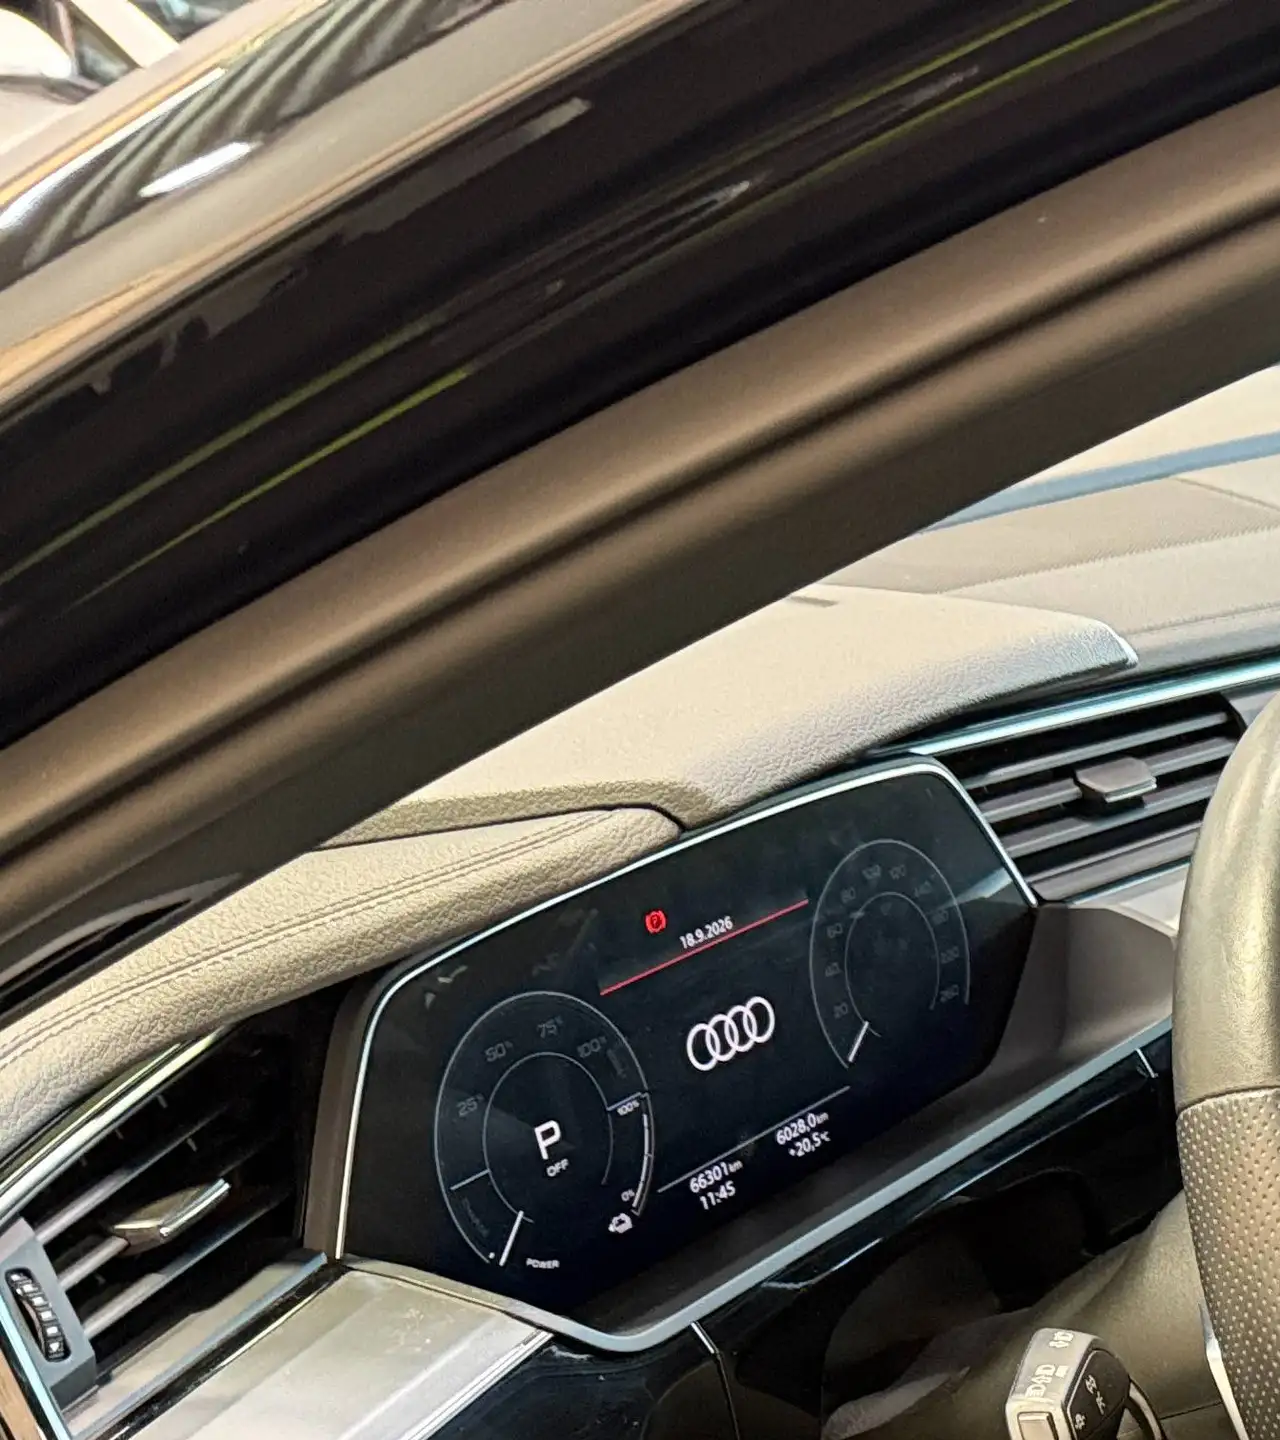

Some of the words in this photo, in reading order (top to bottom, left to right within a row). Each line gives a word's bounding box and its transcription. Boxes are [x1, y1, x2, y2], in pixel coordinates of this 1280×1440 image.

[679, 915, 734, 949] 18.9.2026
[534, 1119, 562, 1160] P
[546, 1158, 570, 1178] OFF
[699, 1180, 736, 1210] 11:45
[525, 1257, 560, 1270] POWER
